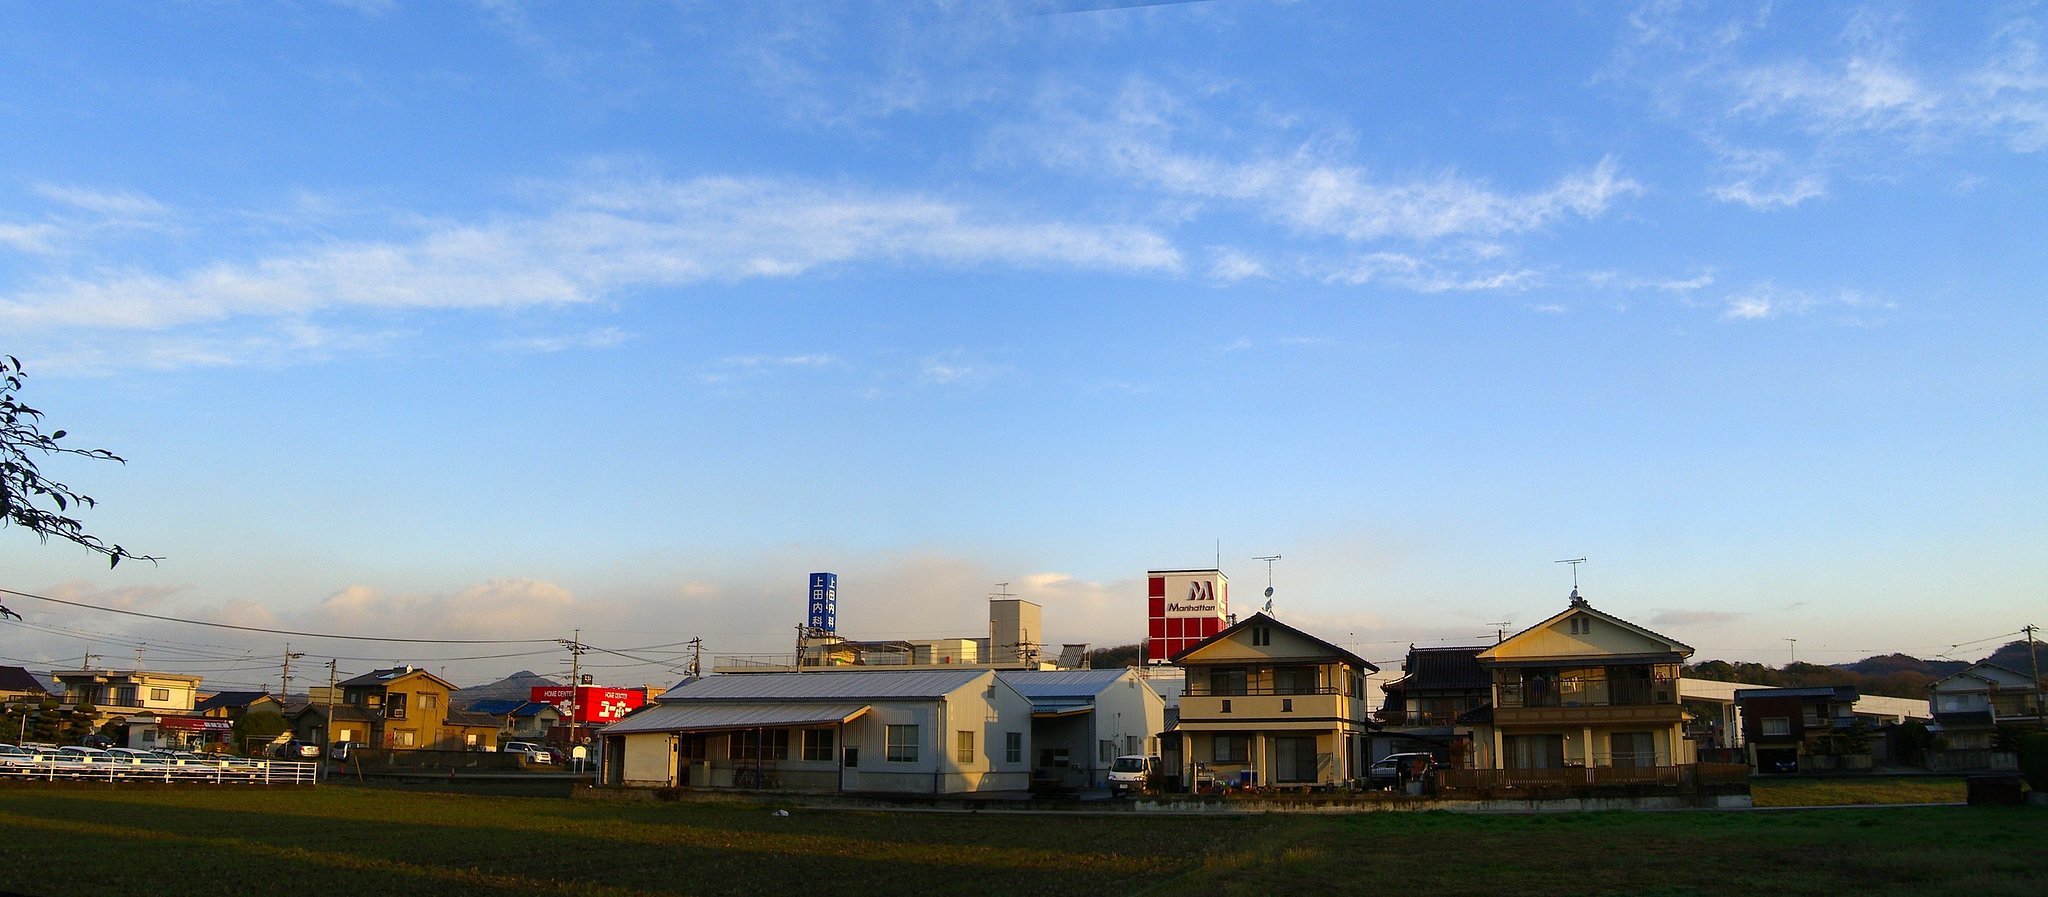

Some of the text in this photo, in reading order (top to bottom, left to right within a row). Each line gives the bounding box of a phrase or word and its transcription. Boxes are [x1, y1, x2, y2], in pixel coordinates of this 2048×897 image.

[812, 576, 824, 627] 上田内科
[828, 577, 836, 628] 上田内科
[1167, 602, 1216, 612] Manhattan
[544, 690, 574, 698] HOME CENTE
[598, 700, 633, 718] ユーホー
